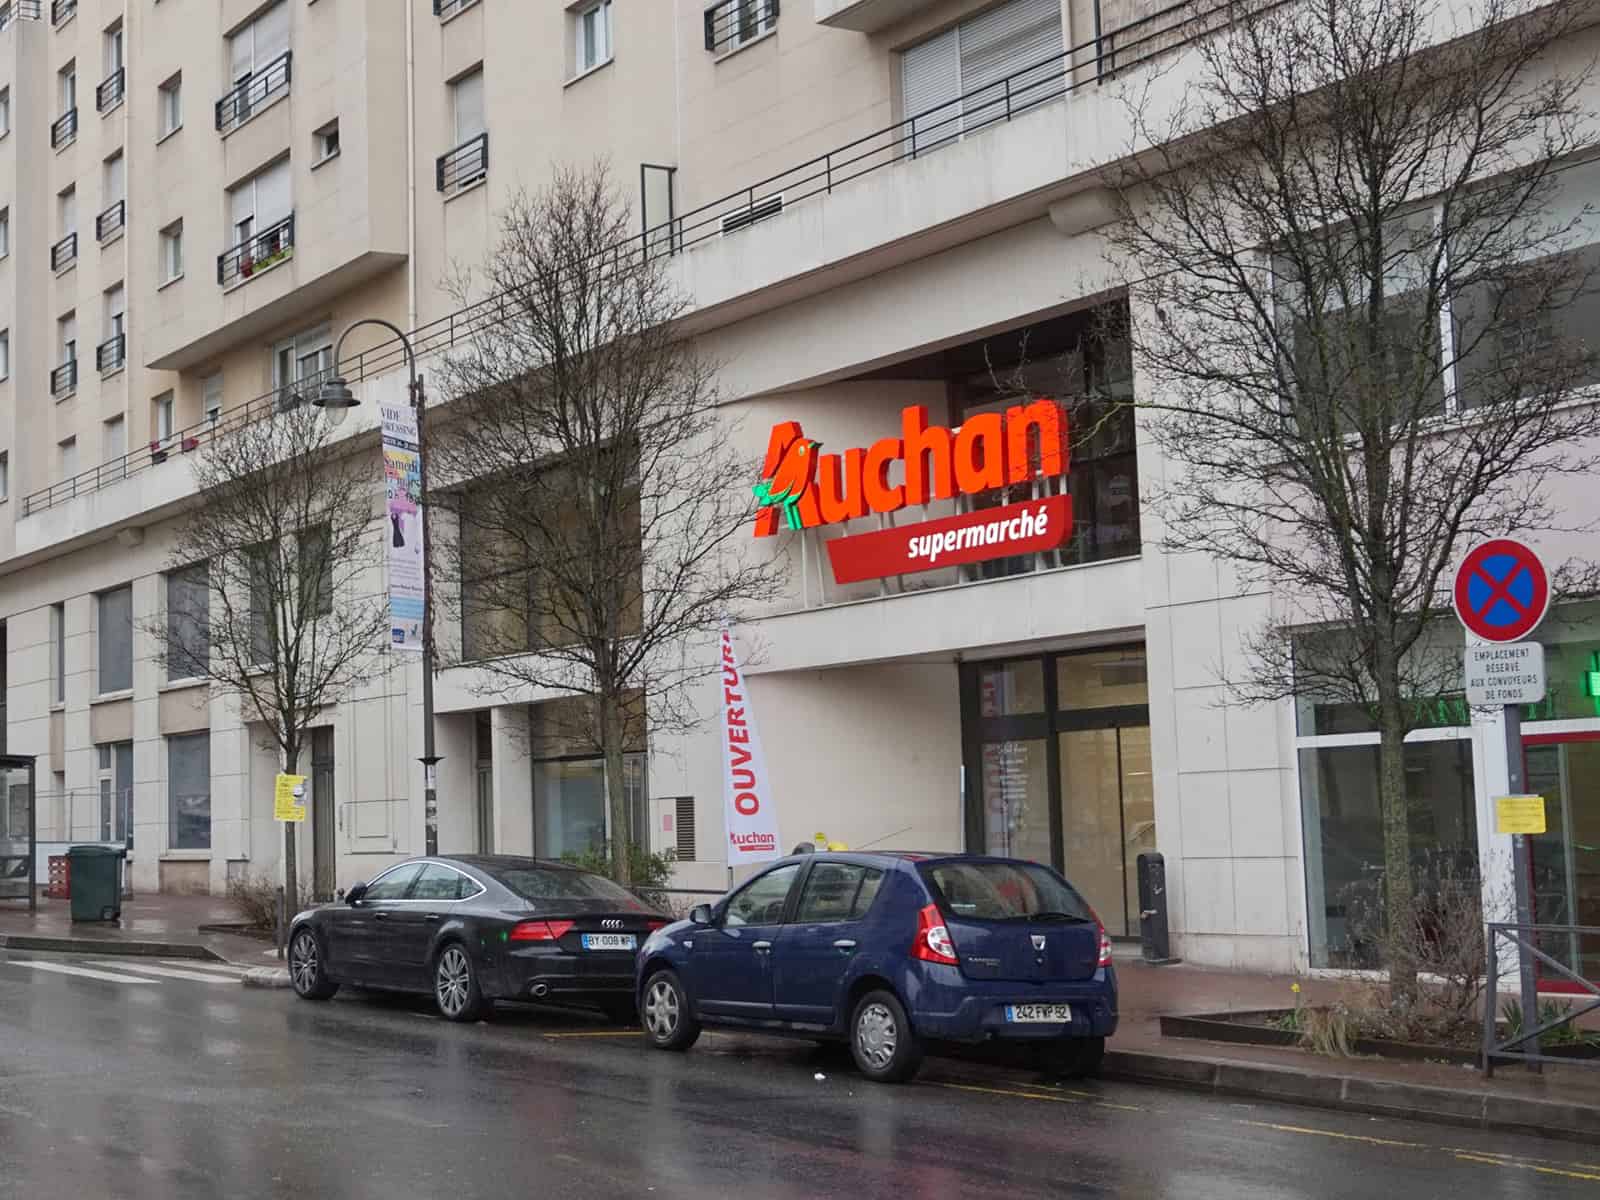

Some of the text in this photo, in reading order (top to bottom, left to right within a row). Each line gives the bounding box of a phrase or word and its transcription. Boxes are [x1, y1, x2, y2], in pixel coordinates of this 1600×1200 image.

[753, 399, 1069, 538] Auchan
[907, 505, 1048, 562] supermarché
[1474, 648, 1530, 661] EMPLACEMENT
[1471, 674, 1537, 687] AUX CONVOYEURS
[1485, 689, 1523, 700] DE FONDS
[1016, 1006, 1034, 1019] 242
